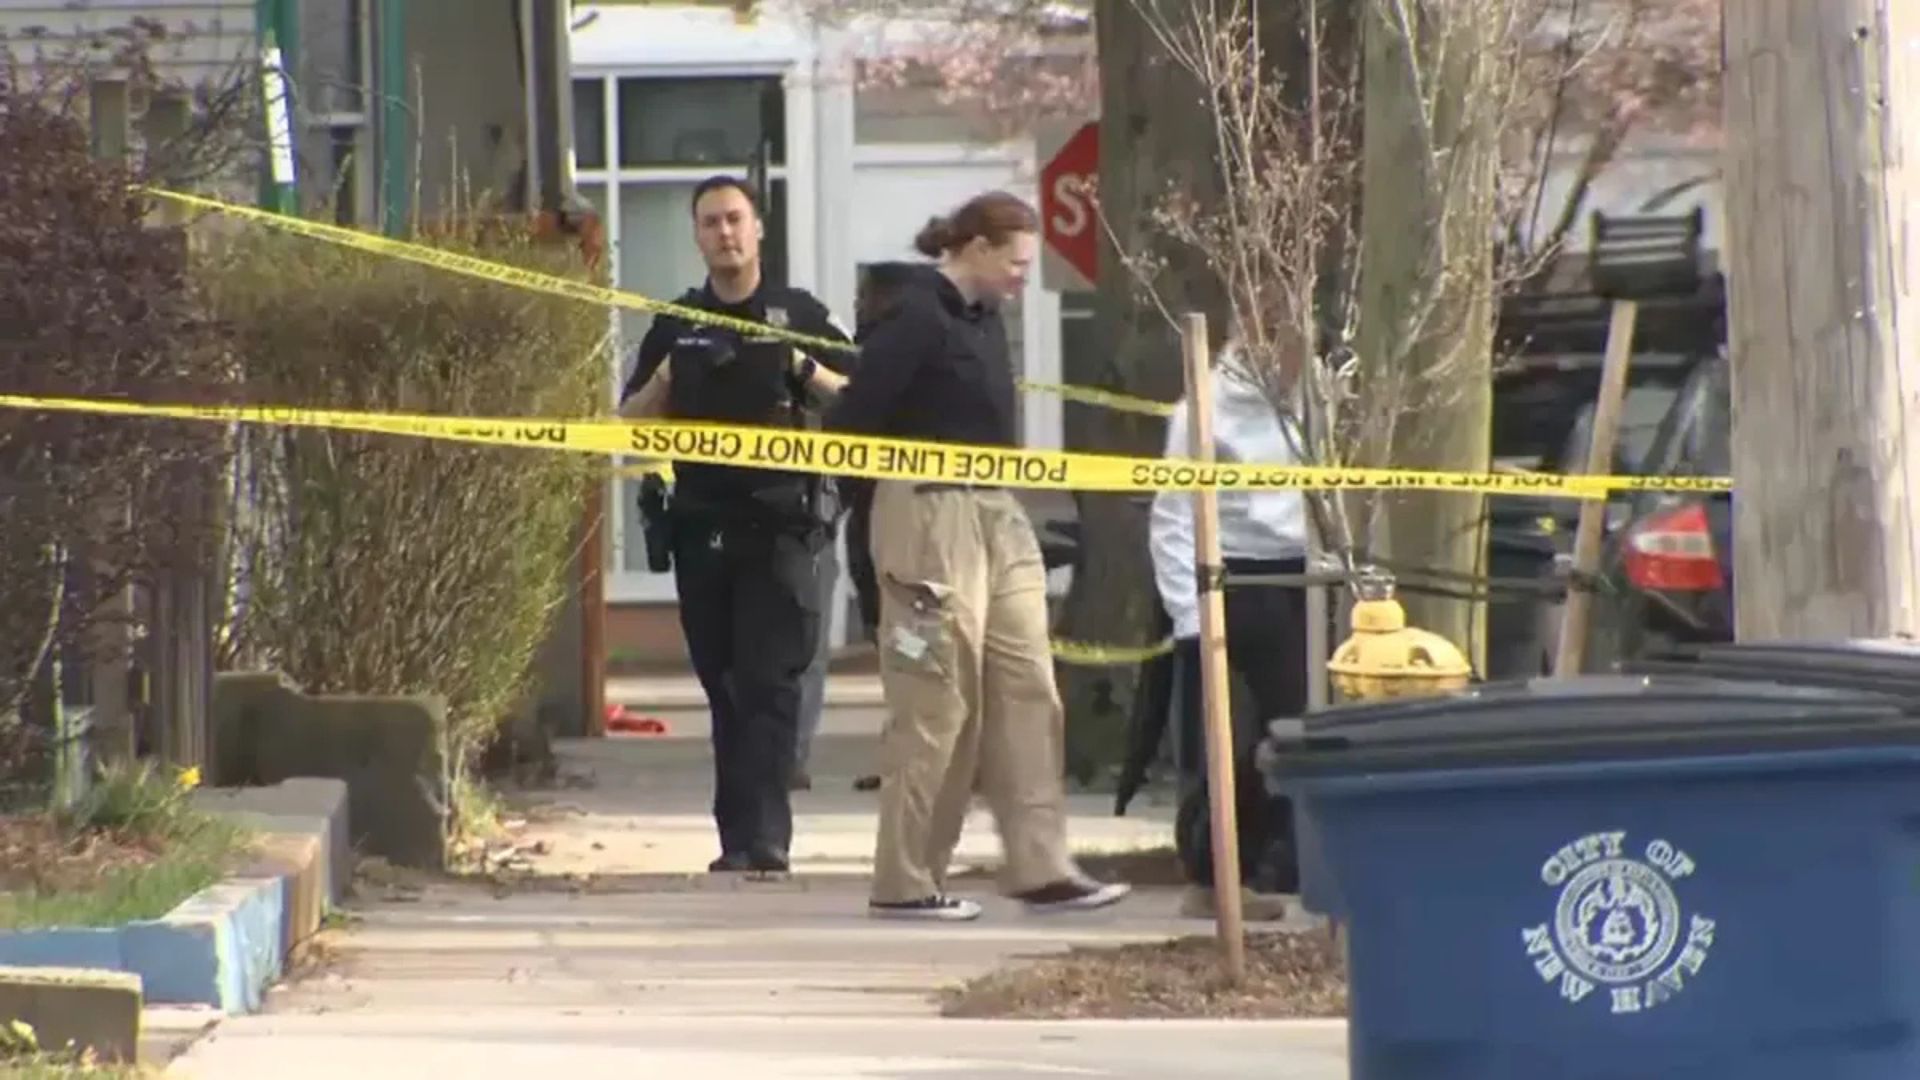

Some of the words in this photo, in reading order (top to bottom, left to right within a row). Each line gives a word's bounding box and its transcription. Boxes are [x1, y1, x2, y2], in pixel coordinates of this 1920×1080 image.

[631, 428, 742, 459] CROSS
[748, 435, 814, 465] NOT
[822, 440, 868, 470] DO
[877, 445, 945, 475] LINE
[953, 452, 1068, 483] POLICE
[1541, 831, 1626, 886] CITY
[1645, 838, 1696, 879] OF
[1521, 922, 1595, 1003] NEW
[1609, 913, 1716, 1014] HAVEN
